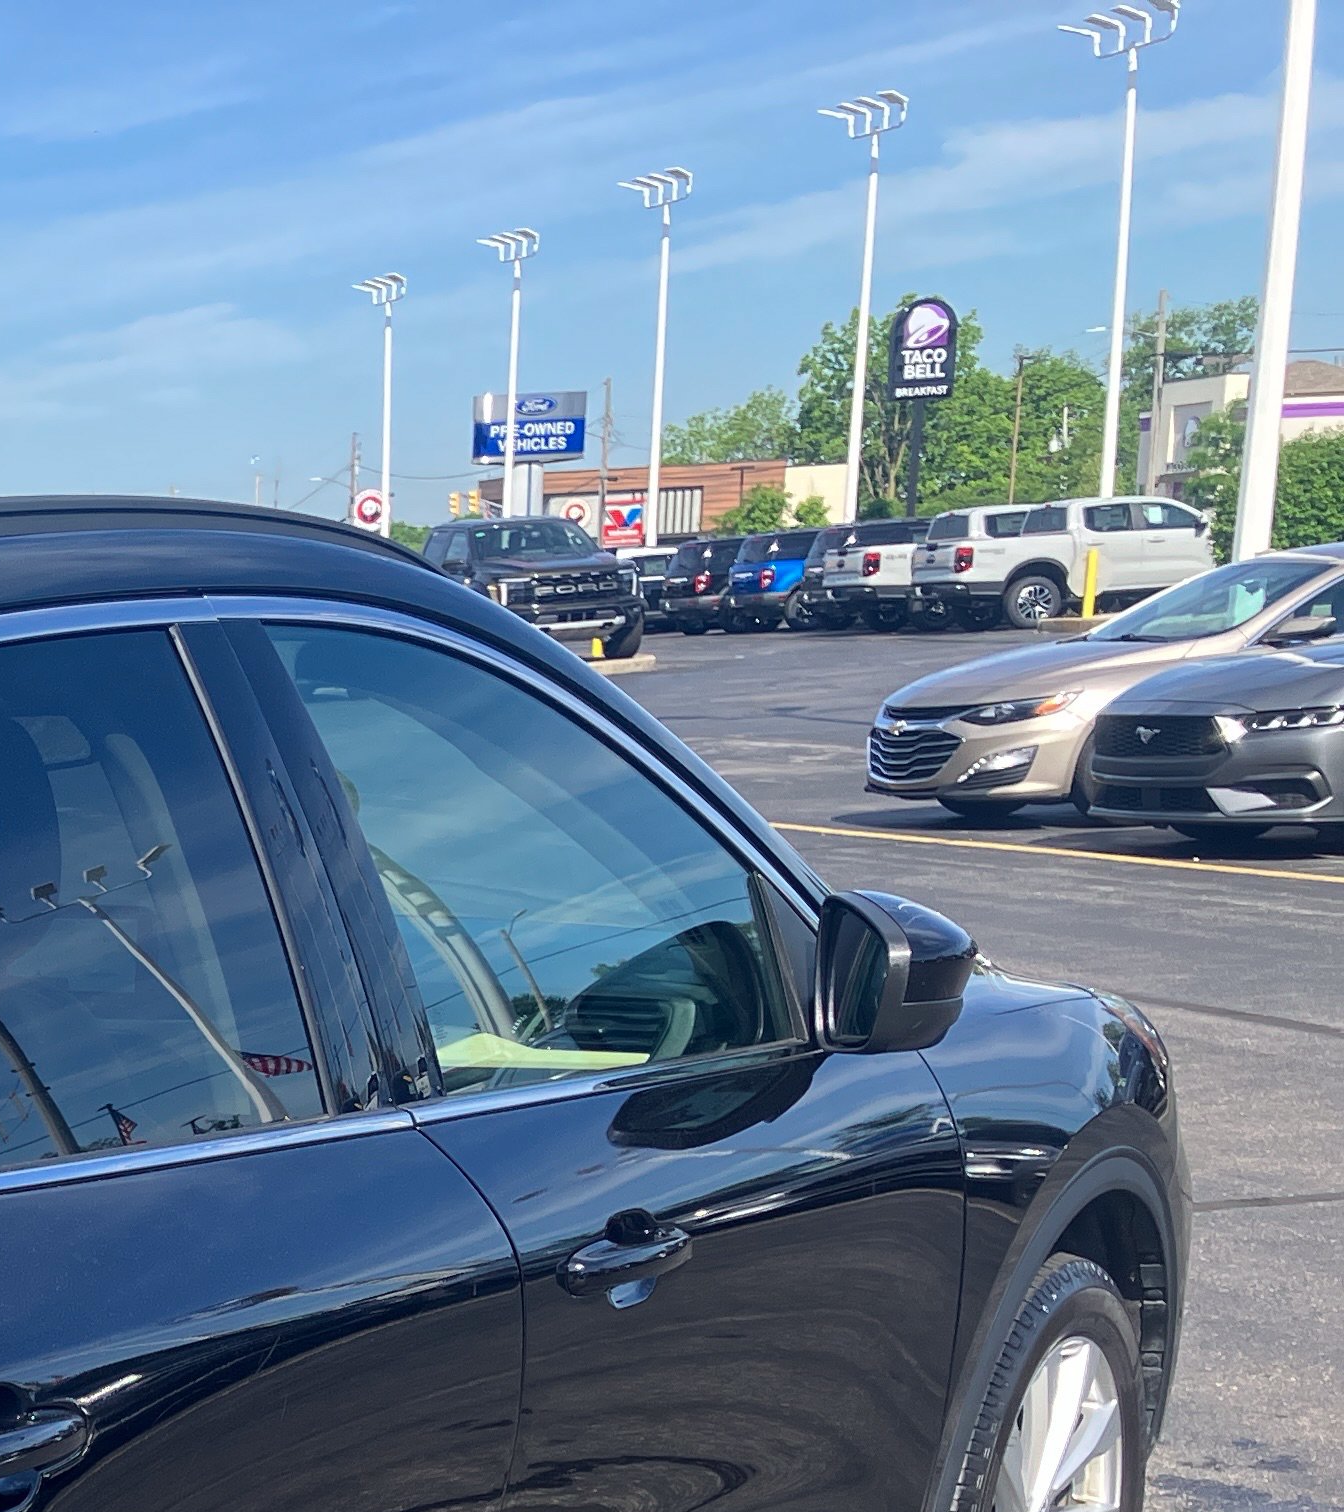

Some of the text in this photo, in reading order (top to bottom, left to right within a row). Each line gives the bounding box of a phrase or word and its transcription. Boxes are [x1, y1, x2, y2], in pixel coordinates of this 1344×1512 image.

[901, 348, 948, 364] TACO
[903, 363, 946, 380] BELL
[895, 385, 949, 398] BREAKFAST
[534, 581, 618, 597] FORD
